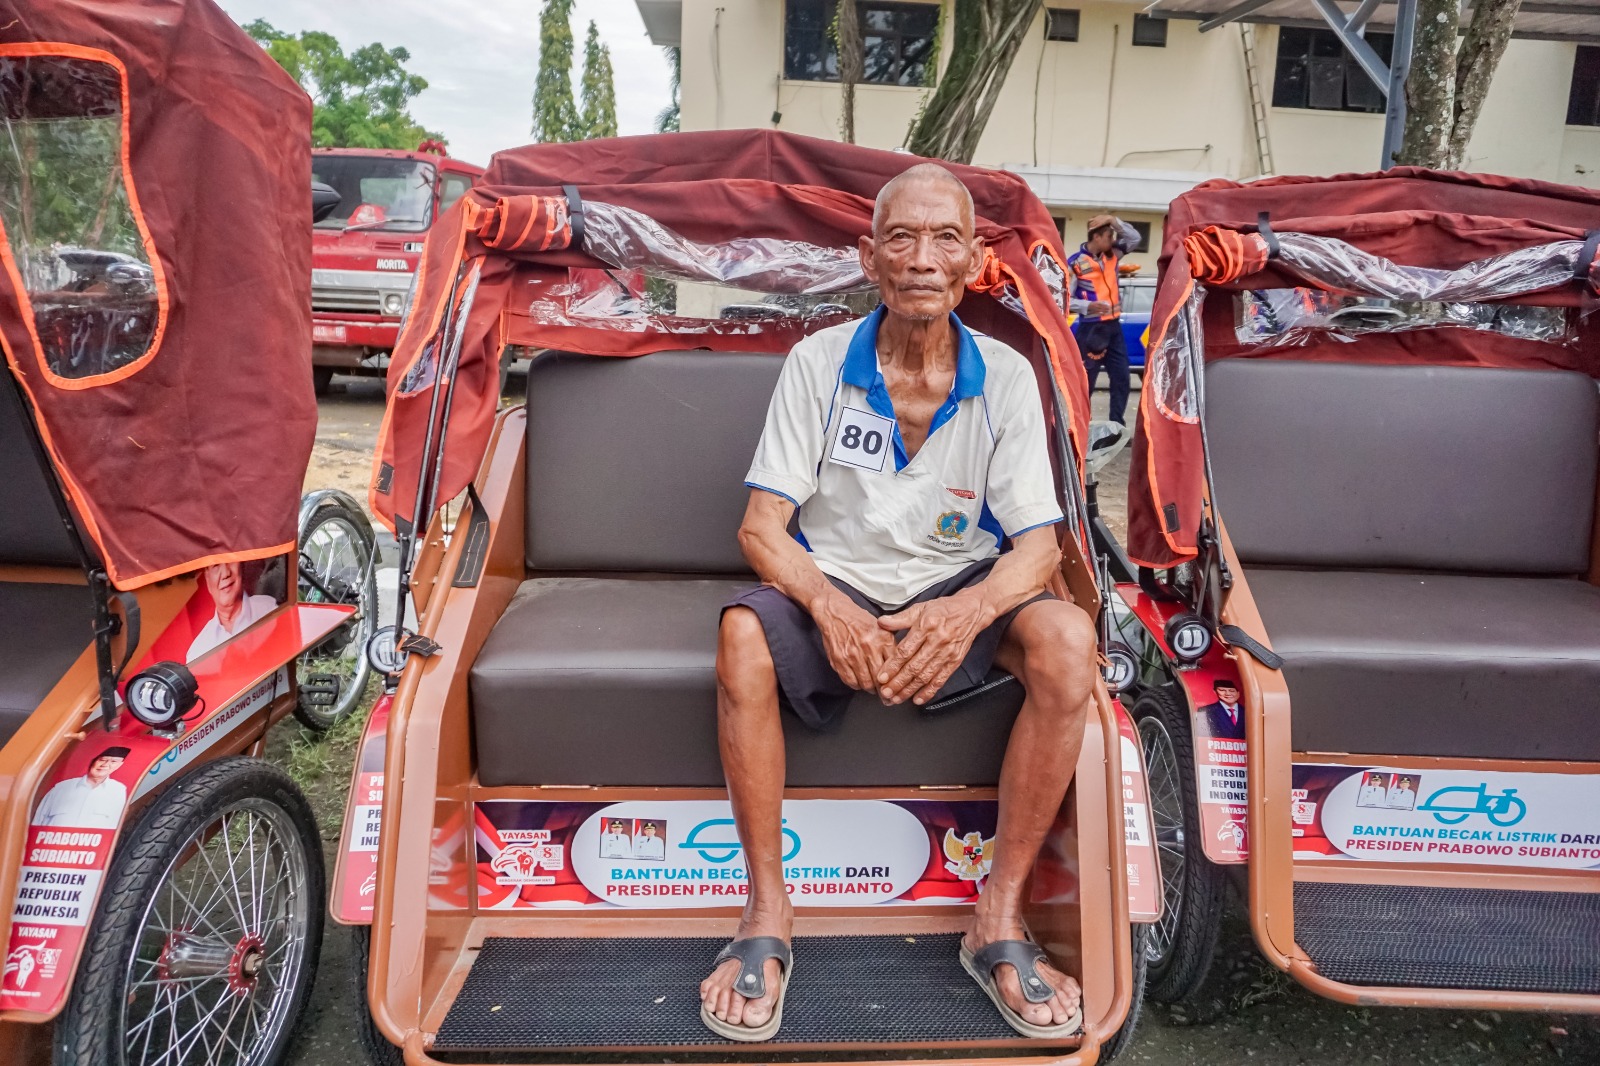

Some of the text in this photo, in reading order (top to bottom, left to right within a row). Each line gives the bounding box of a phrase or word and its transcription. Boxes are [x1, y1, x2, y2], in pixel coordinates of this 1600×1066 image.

[376, 258, 409, 271] MORITA
[841, 425, 883, 455] 80
[178, 674, 283, 754] PRESIDEN PRABOWO SUBIANO
[1207, 740, 1247, 751] PRABOW
[1208, 753, 1247, 763] SUBIAN
[1210, 769, 1247, 778] PRESID
[1211, 780, 1247, 789] REPUB
[1209, 791, 1247, 800] INDONE
[1220, 807, 1247, 815] YAYASA
[35, 831, 102, 847] PRABOWO
[502, 832, 548, 840] YAYASAN
[1352, 825, 1600, 845] BANTUAN BECAK LISTRIK DARI
[1346, 839, 1600, 859] PRESIDEN PRABOWO SUBIANTO
[30, 848, 96, 865] SUBIANTO
[24, 871, 87, 885] PRESIDEN
[611, 866, 890, 880] BANTUAN BEC ISTRIK DARI
[19, 887, 82, 902] REPUBLIK
[606, 882, 894, 896] PRESIDEN PRABO SUBIANTO
[14, 904, 79, 919] NDONESIA
[18, 926, 58, 939] YAYASAN
